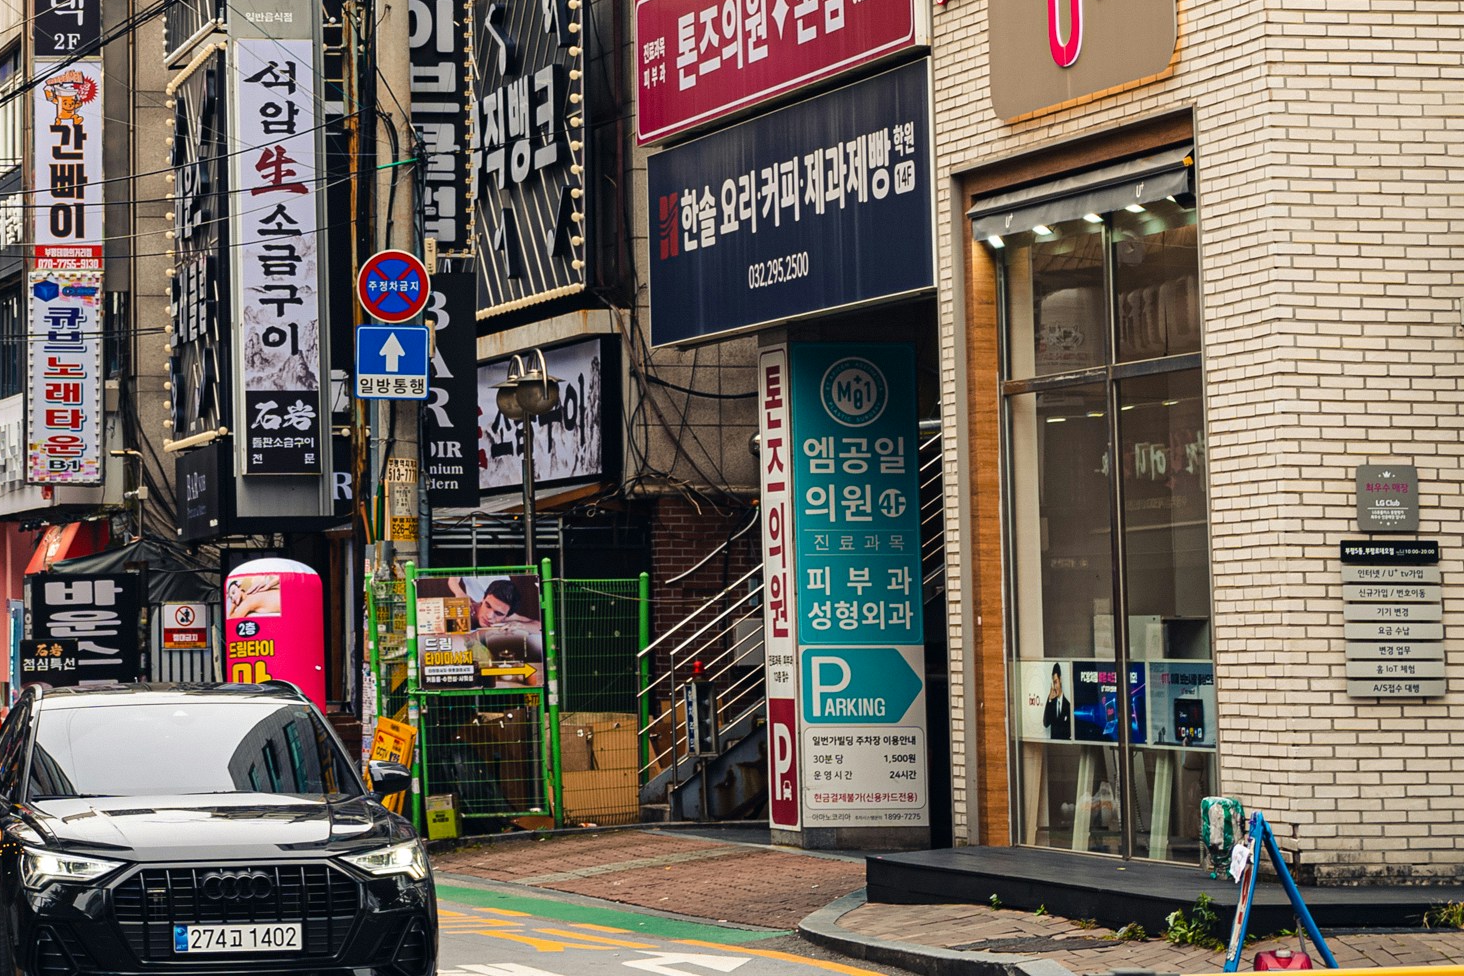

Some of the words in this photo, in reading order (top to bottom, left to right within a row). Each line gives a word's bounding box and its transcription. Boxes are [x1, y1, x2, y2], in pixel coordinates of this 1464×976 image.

[244, 12, 293, 23] 일반음식점
[53, 33, 81, 50] 2F
[643, 36, 666, 65] 진료과목
[643, 62, 667, 90] 피부과
[893, 120, 915, 157] 학원
[49, 123, 89, 240] 간빠이
[897, 163, 913, 191] 14F
[680, 185, 717, 252] 한솔
[37, 259, 99, 271] 070-7755-9130
[368, 279, 420, 293] 주정차금지
[358, 376, 426, 395] 일방통행
[251, 402, 317, 432] 石岩
[802, 436, 906, 475] 엠공일
[49, 459, 81, 472] B1
[1366, 483, 1390, 493] 최우수
[764, 364, 790, 639] 톤즈의원
[804, 483, 873, 523] 의원
[1376, 499, 1385, 507] LG
[1386, 499, 1401, 507] Club
[814, 534, 906, 552] 진료과목
[807, 566, 912, 596] 피부과
[1357, 569, 1381, 579] 인터넷
[1358, 589, 1388, 598] 신규가입
[1396, 589, 1426, 598] 번호이동
[807, 600, 914, 630] 성형외과
[1377, 608, 1392, 617] 기기
[1394, 608, 1409, 617] 변경
[238, 621, 257, 636] 2층
[1378, 626, 1392, 636] 요금
[1394, 626, 1410, 636] 수납
[228, 639, 275, 660] 드림타이
[425, 637, 452, 652] 드림
[1379, 645, 1394, 655] 변경
[1396, 645, 1411, 655] 업무
[22, 658, 77, 672] 점심특선
[1386, 665, 1398, 673] IoT
[1400, 665, 1416, 674] 체험
[811, 656, 886, 717] PARKING
[1405, 684, 1420, 694] 대행
[812, 735, 854, 747] 일번가빌딩
[855, 735, 881, 746] 주차장
[882, 735, 917, 746] 이용안내
[813, 754, 833, 764] 30분
[835, 754, 844, 764] 당
[883, 754, 917, 764] 1,500원
[889, 770, 918, 780] 24시간
[813, 792, 919, 803] 현금결제불가(신용카드전용)
[811, 813, 852, 821] 아마노코리아
[884, 813, 922, 821] 1899-7275
[191, 928, 243, 949] 274고
[249, 927, 297, 948] 1402
